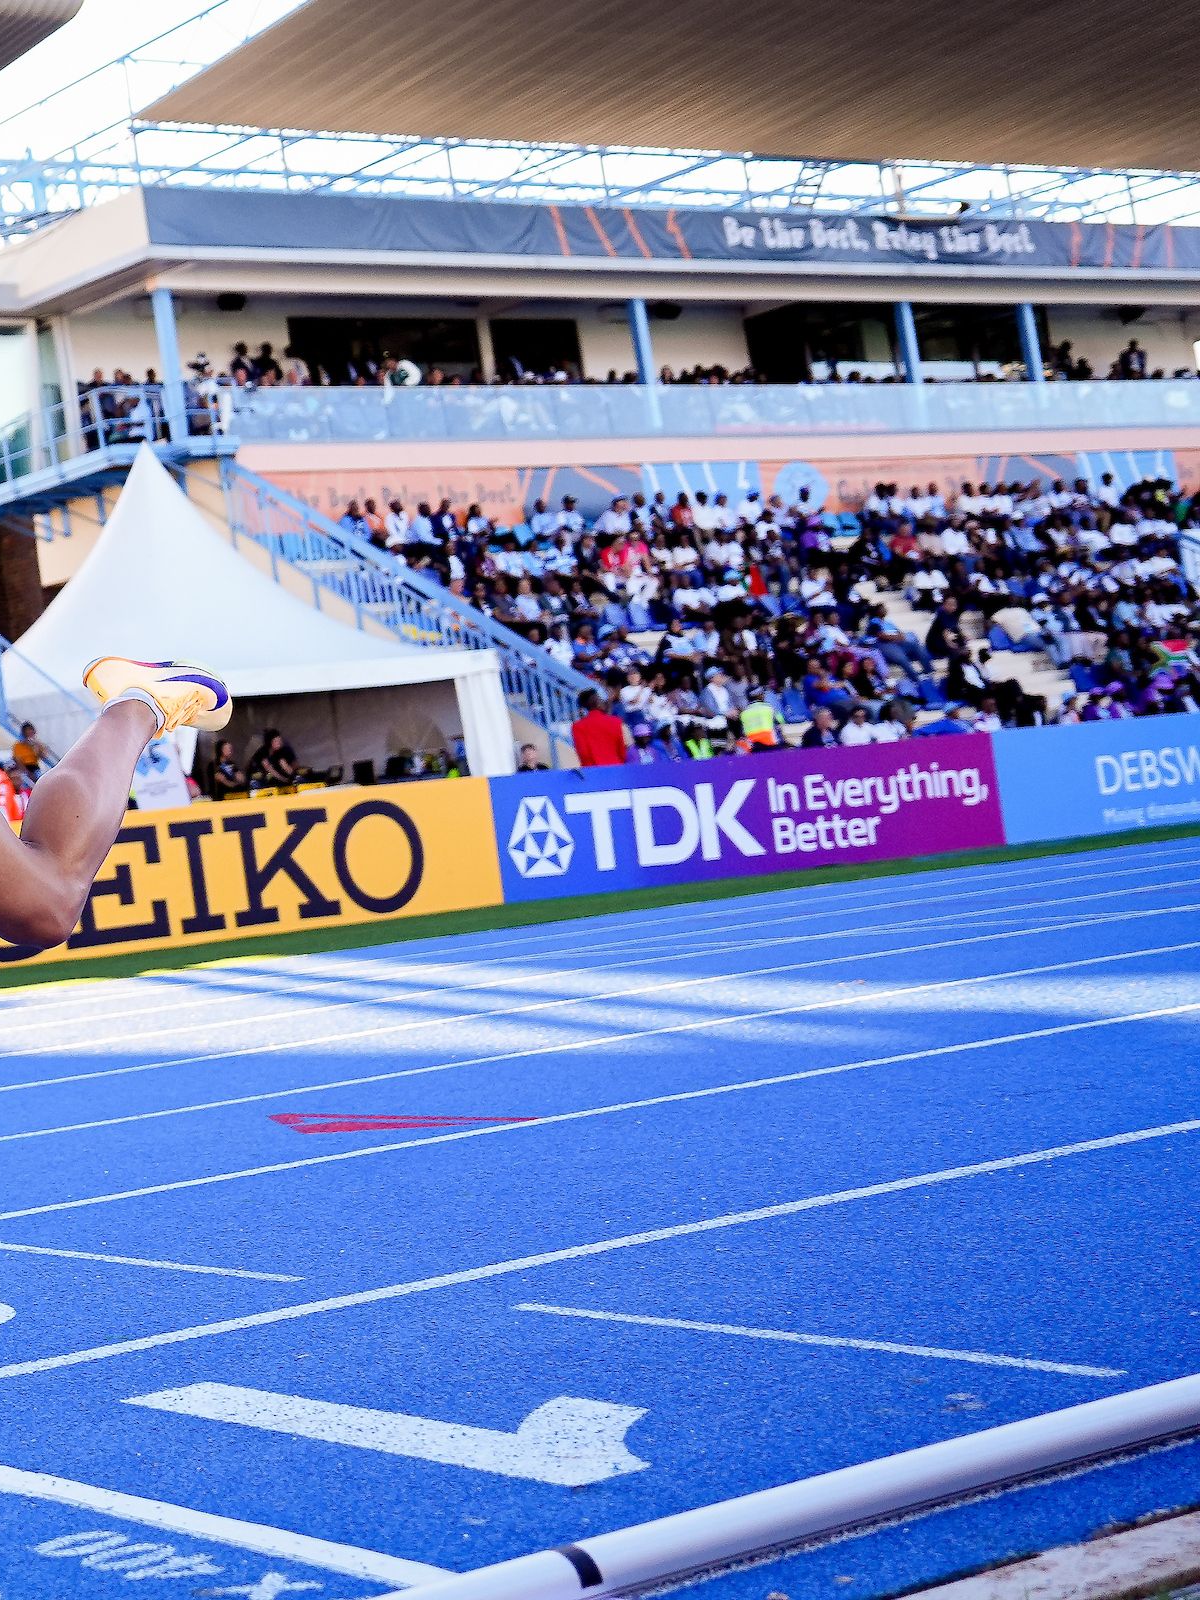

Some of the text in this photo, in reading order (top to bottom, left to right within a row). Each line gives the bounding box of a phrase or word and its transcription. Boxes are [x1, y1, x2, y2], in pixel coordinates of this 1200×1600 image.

[723, 216, 754, 248] Be
[759, 217, 805, 249] the
[871, 220, 938, 260] Relay
[940, 225, 981, 252] the
[767, 762, 989, 814] In Everything,
[564, 778, 766, 871] TDK
[771, 814, 881, 853] Better
[120, 1381, 650, 1486] 1
